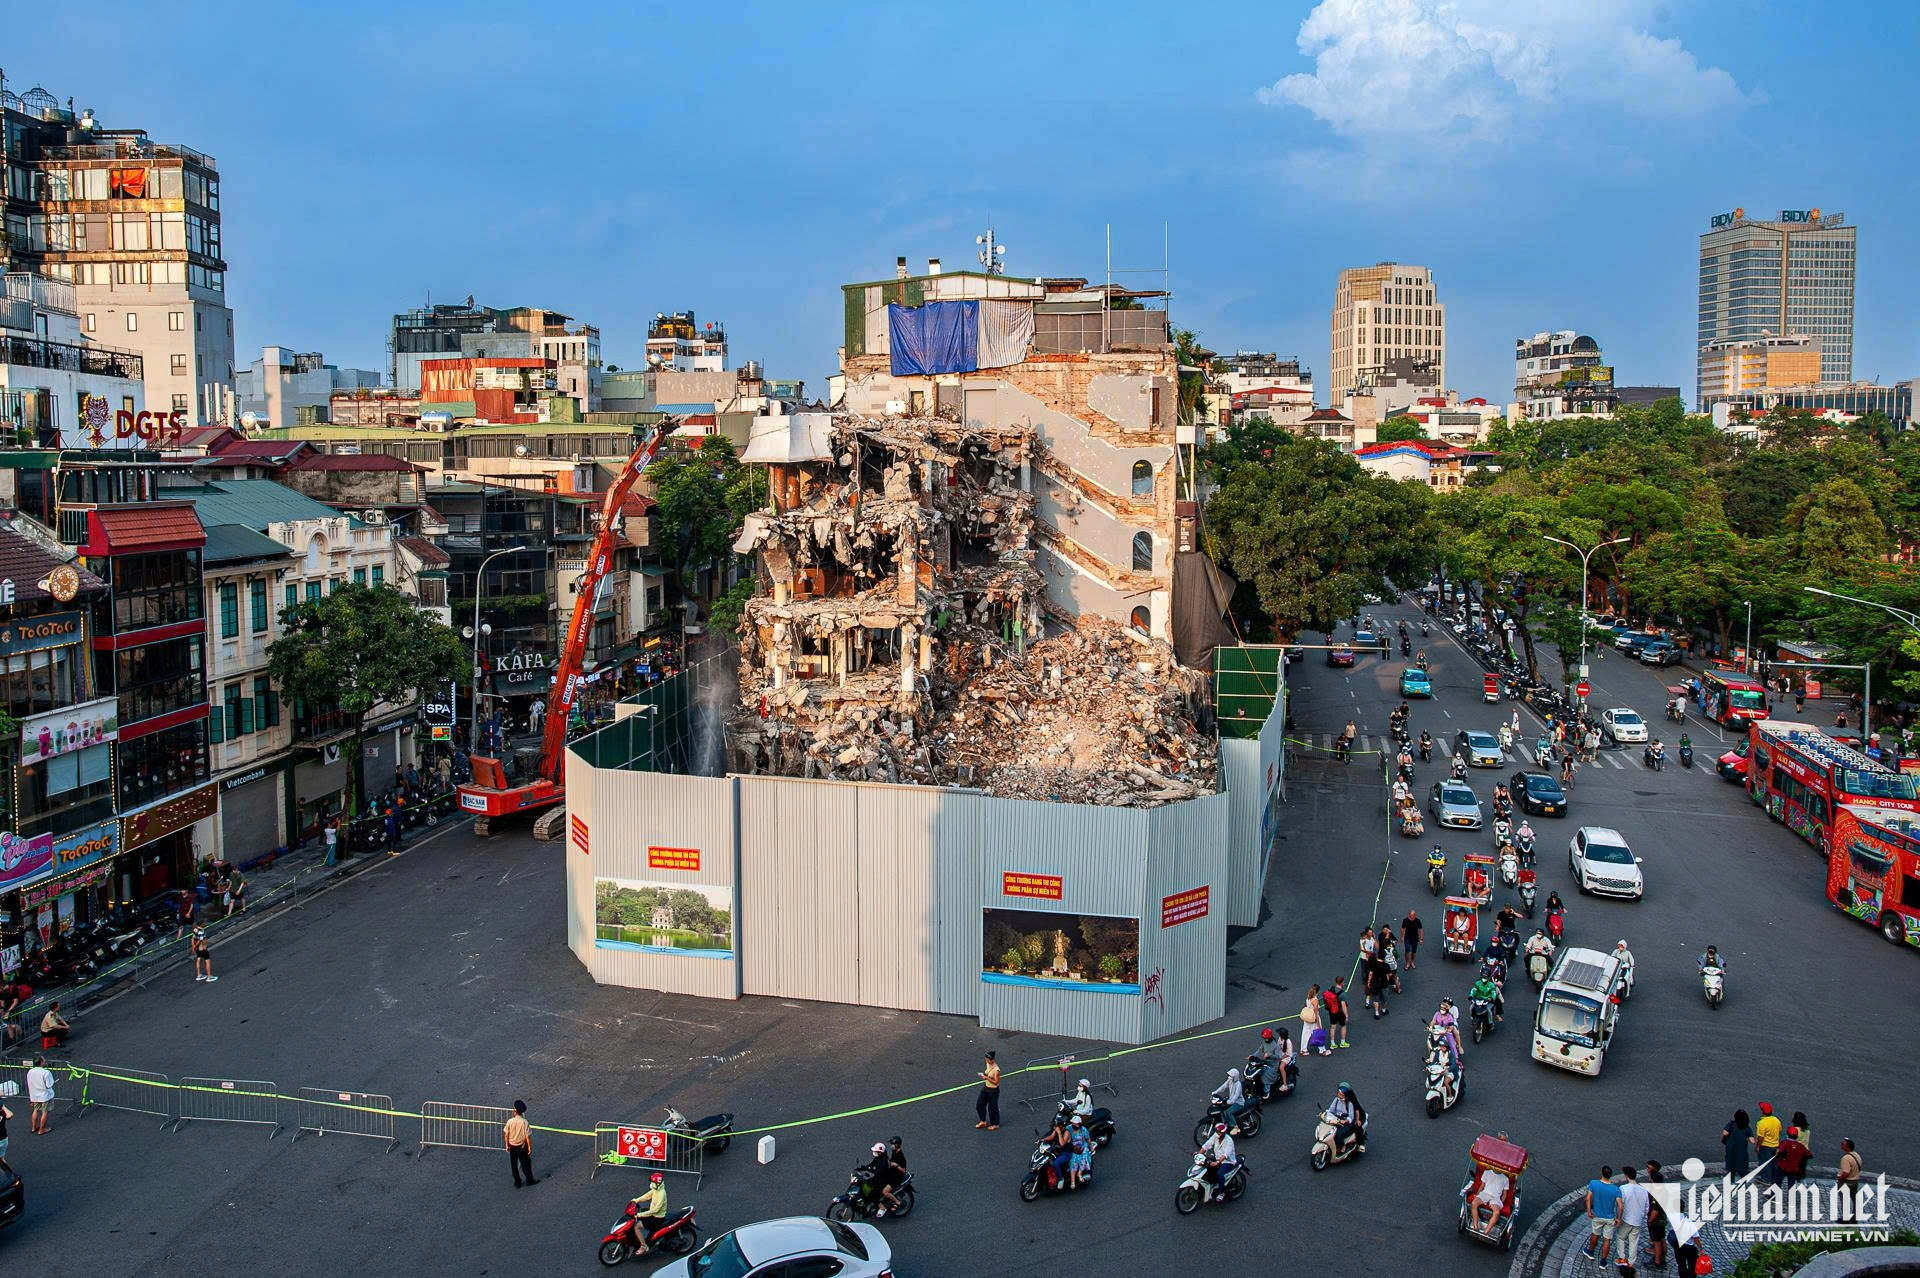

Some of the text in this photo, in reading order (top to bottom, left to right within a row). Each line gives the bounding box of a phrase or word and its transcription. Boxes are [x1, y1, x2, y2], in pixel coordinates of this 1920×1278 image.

[1711, 211, 1735, 228] BIDV
[1782, 210, 1811, 223] BIDV
[114, 409, 182, 440] DGTS
[578, 608, 589, 643] HITACHI
[496, 653, 545, 671] KAFA
[508, 671, 533, 682] Café
[426, 704, 450, 714] SPA
[226, 769, 265, 789] Vietcombank
[1853, 798, 1876, 806] HANOI
